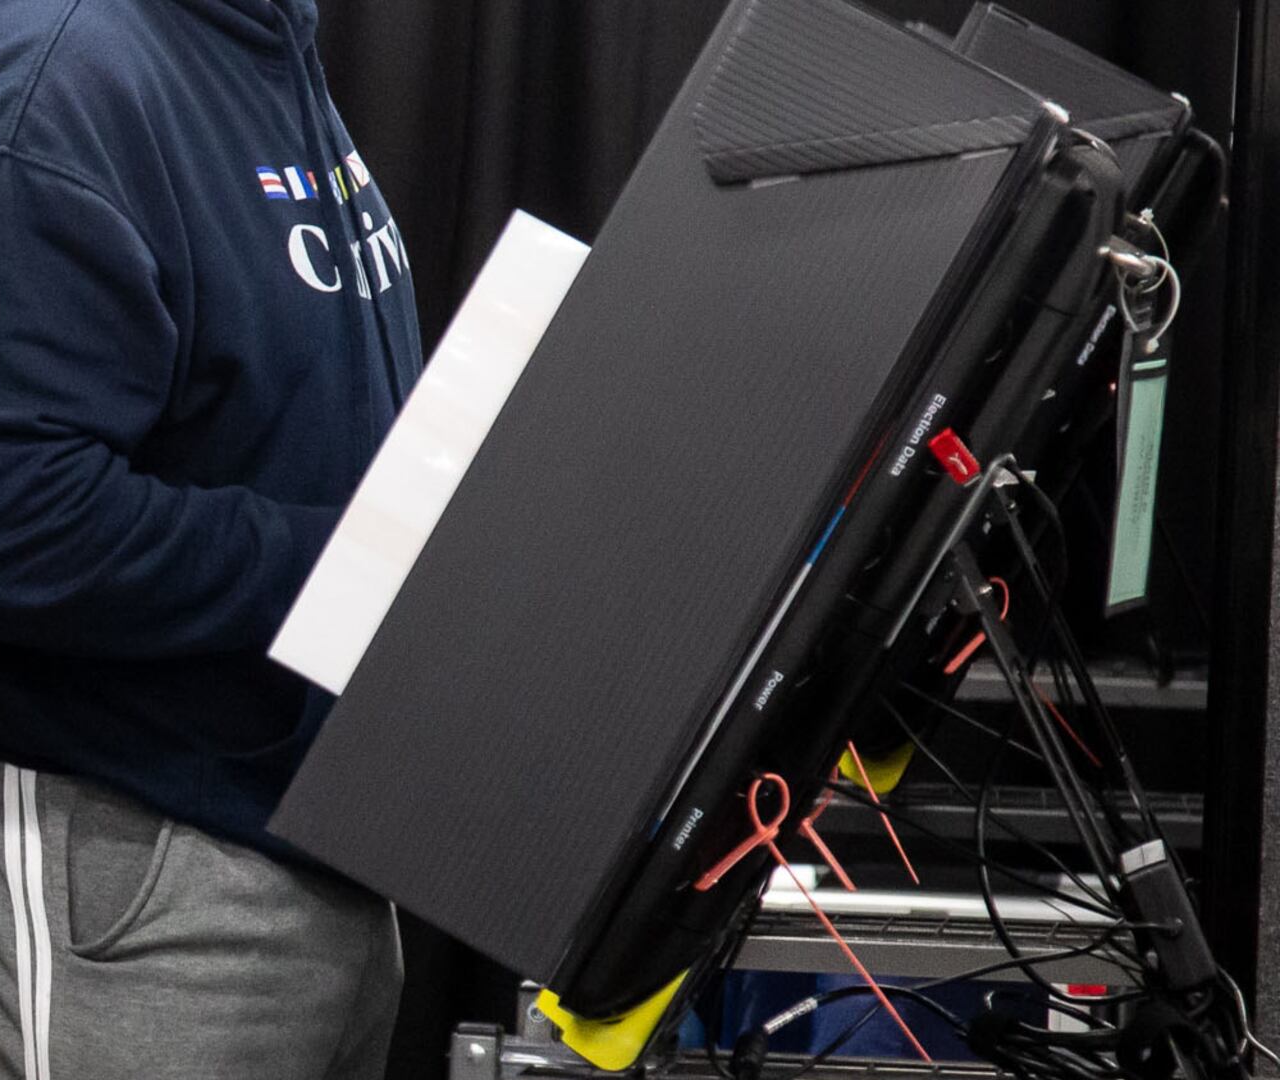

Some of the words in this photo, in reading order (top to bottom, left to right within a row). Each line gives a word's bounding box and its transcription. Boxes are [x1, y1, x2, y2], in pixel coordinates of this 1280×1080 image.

[910, 393, 947, 446] Election
[891, 445, 916, 476] Data
[755, 670, 785, 711] Power
[673, 807, 704, 850] Printer
